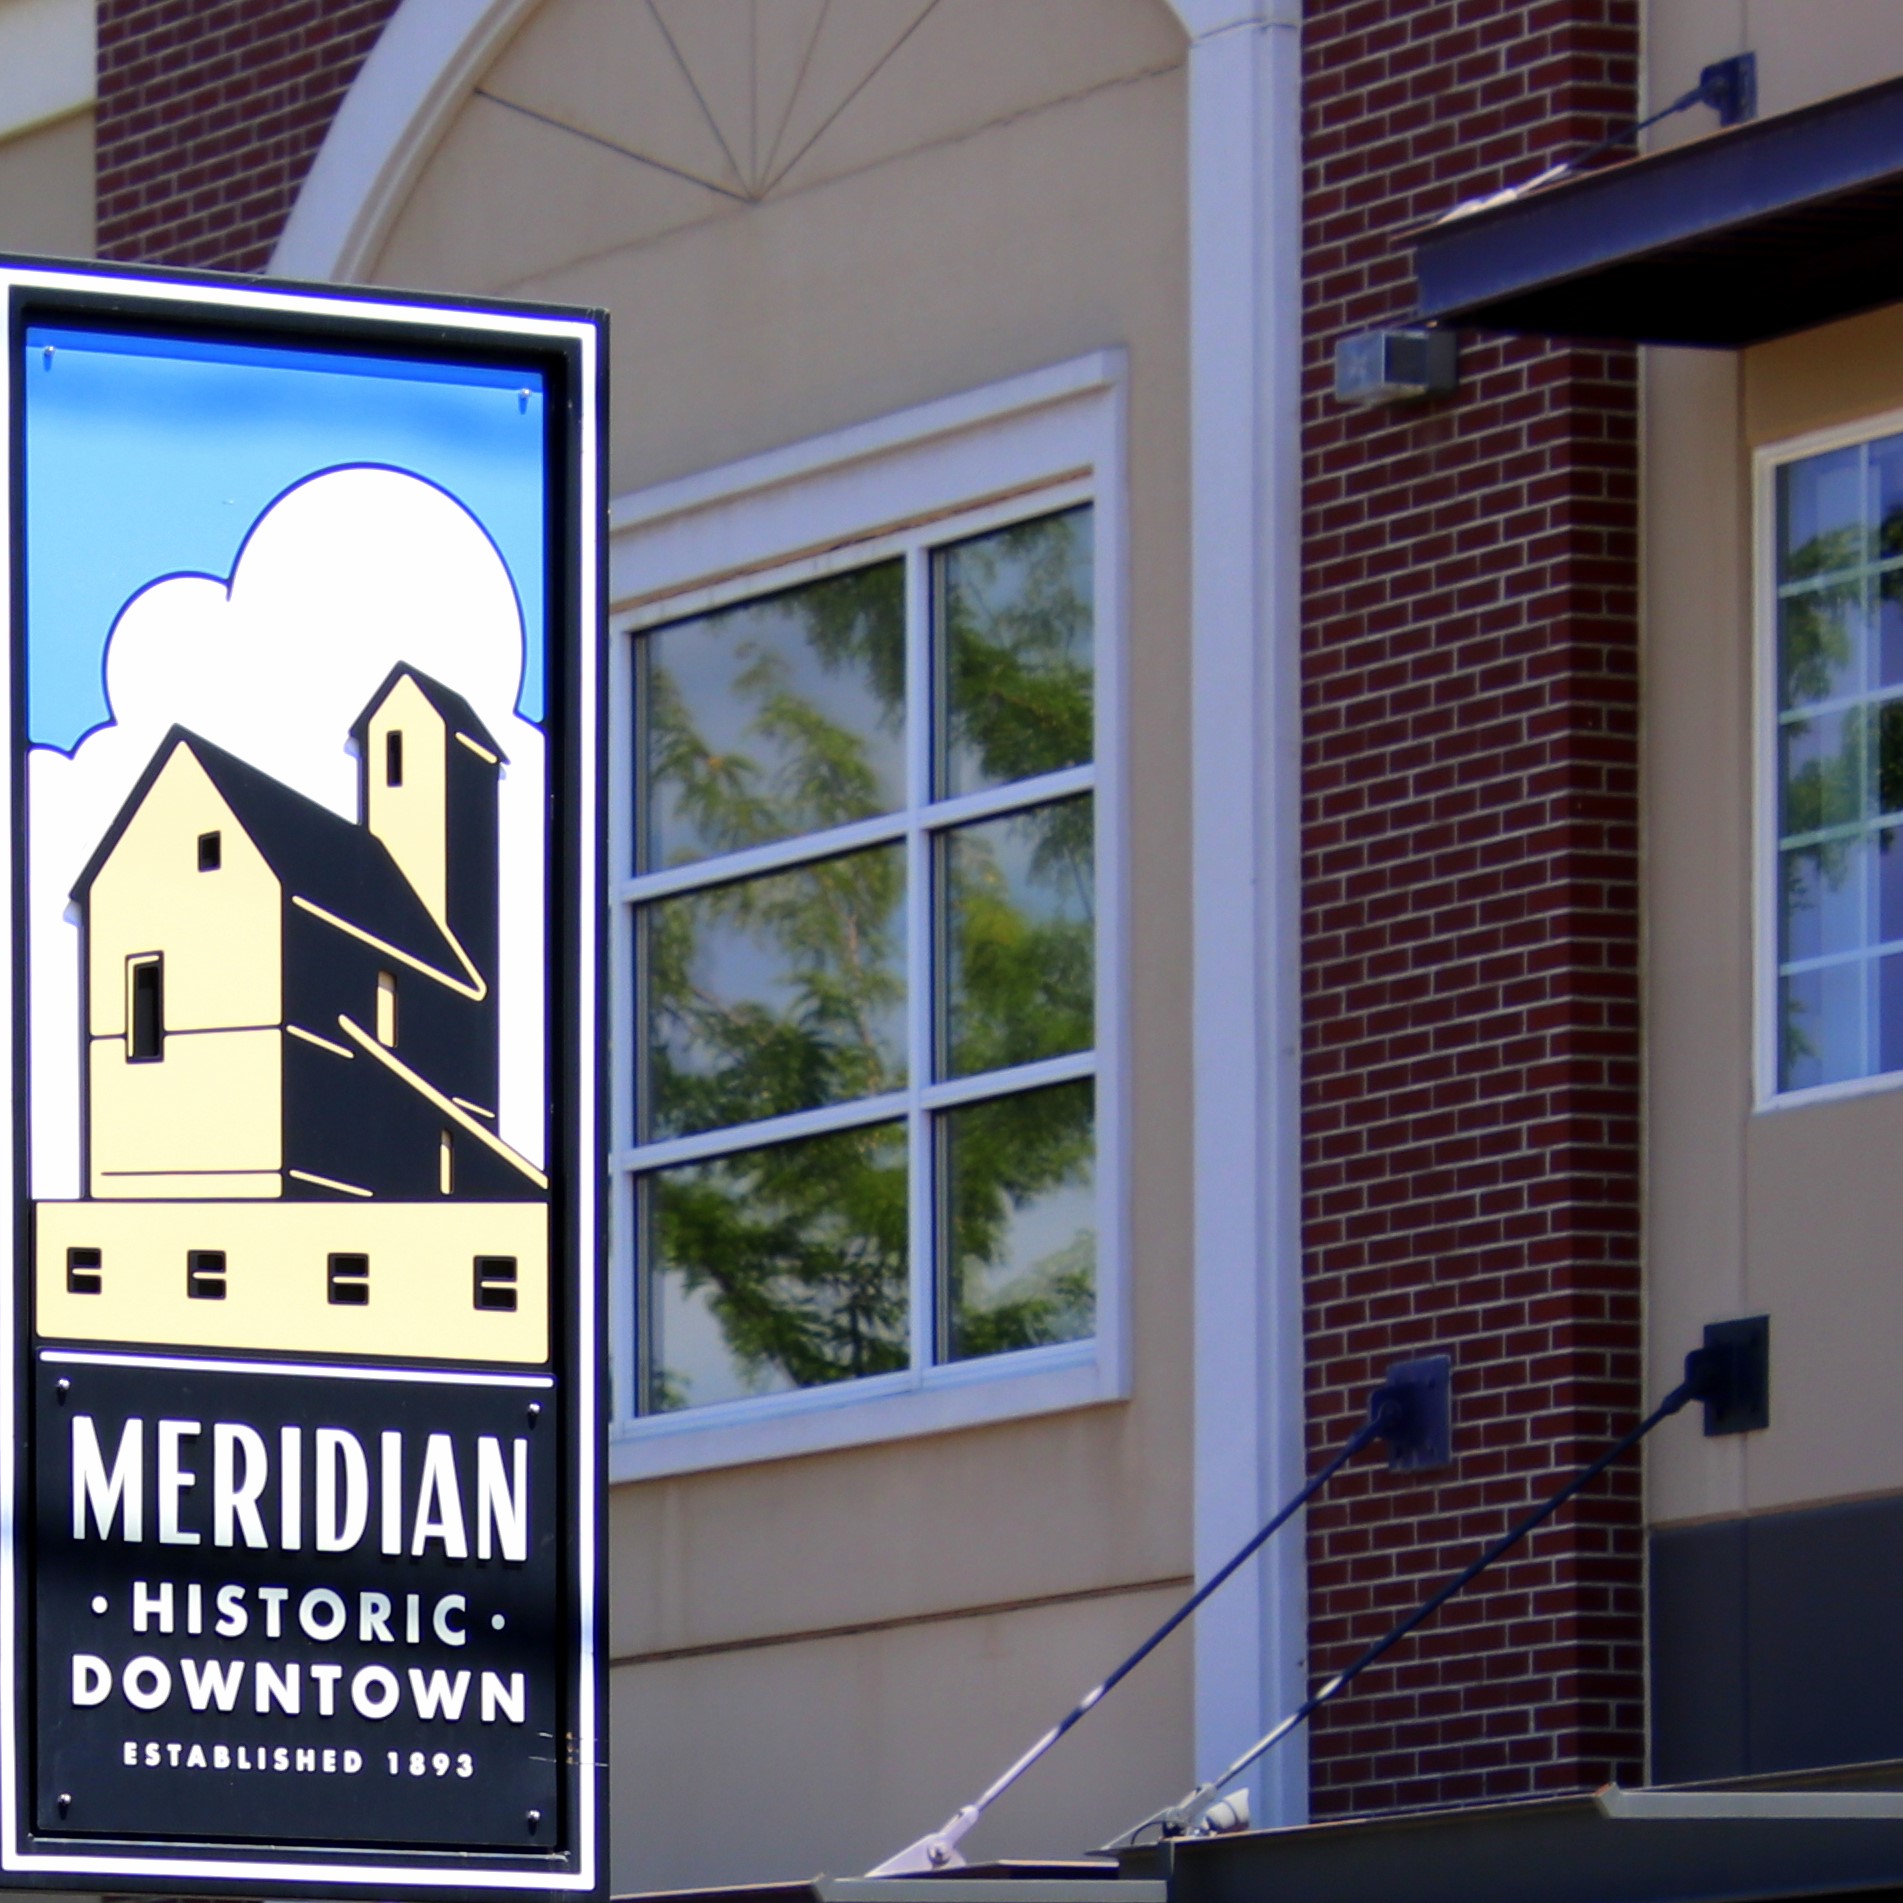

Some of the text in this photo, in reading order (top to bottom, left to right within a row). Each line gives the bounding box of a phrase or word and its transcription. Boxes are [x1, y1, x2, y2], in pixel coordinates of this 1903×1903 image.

[72, 1416, 527, 1561] MERIDIAN
[134, 1582, 465, 1645] HISTORIC
[72, 1655, 524, 1722] DOWNTOWN
[124, 1742, 473, 1777] ESTABLISHED 1893
